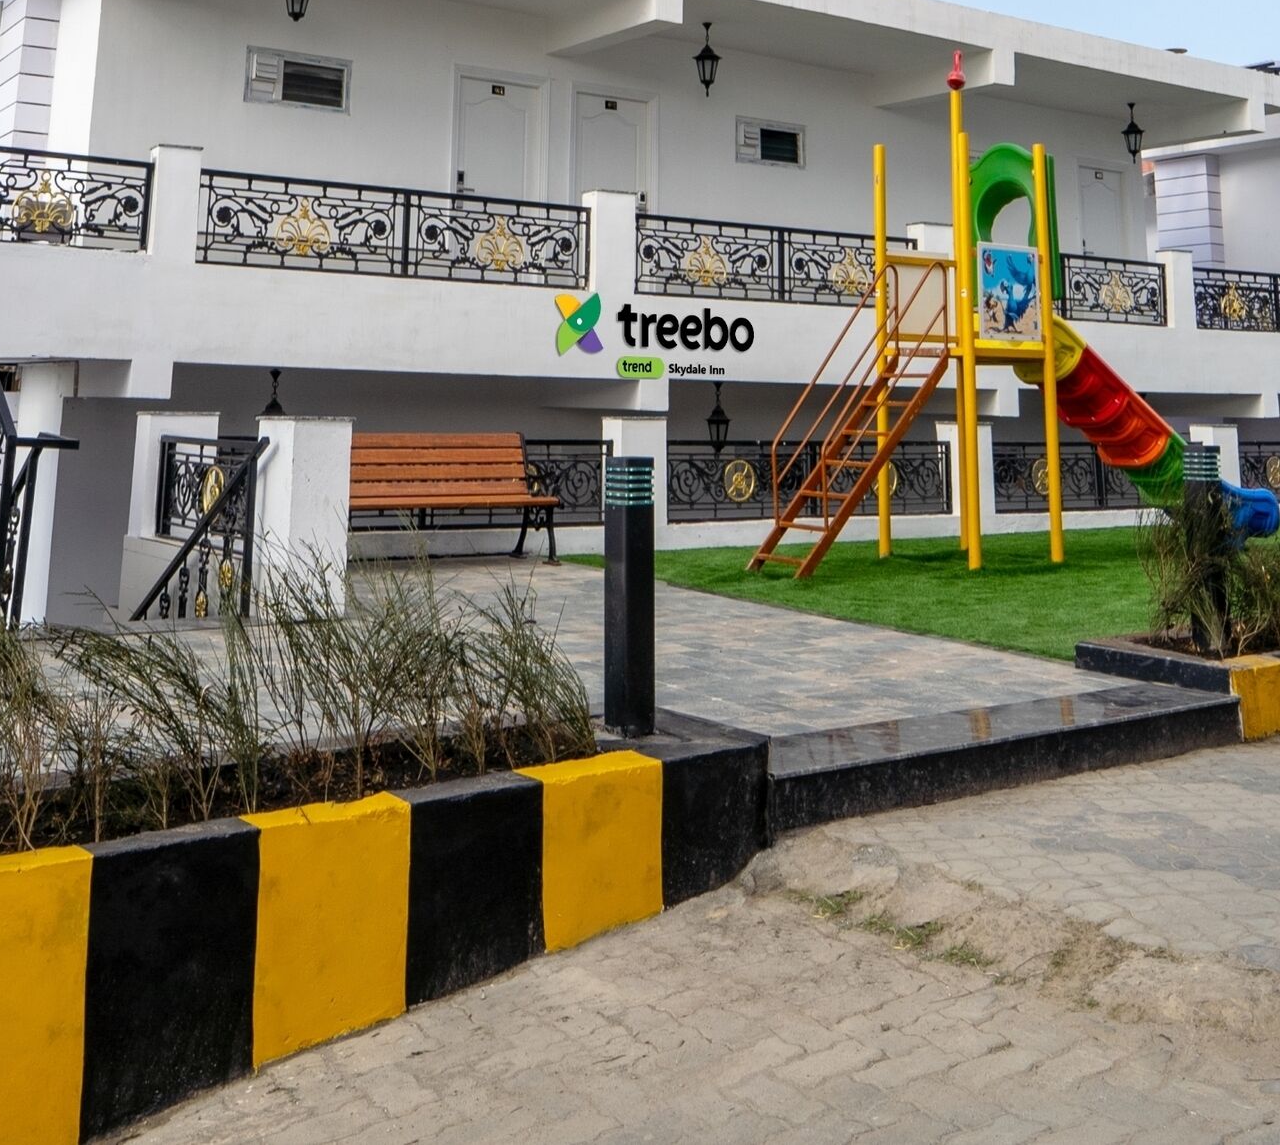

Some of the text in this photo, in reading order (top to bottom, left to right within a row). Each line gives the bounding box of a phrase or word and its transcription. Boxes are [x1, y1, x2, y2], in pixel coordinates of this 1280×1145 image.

[617, 303, 754, 352] treebo
[622, 360, 652, 373] trend
[668, 363, 725, 376] Skydale Inn
